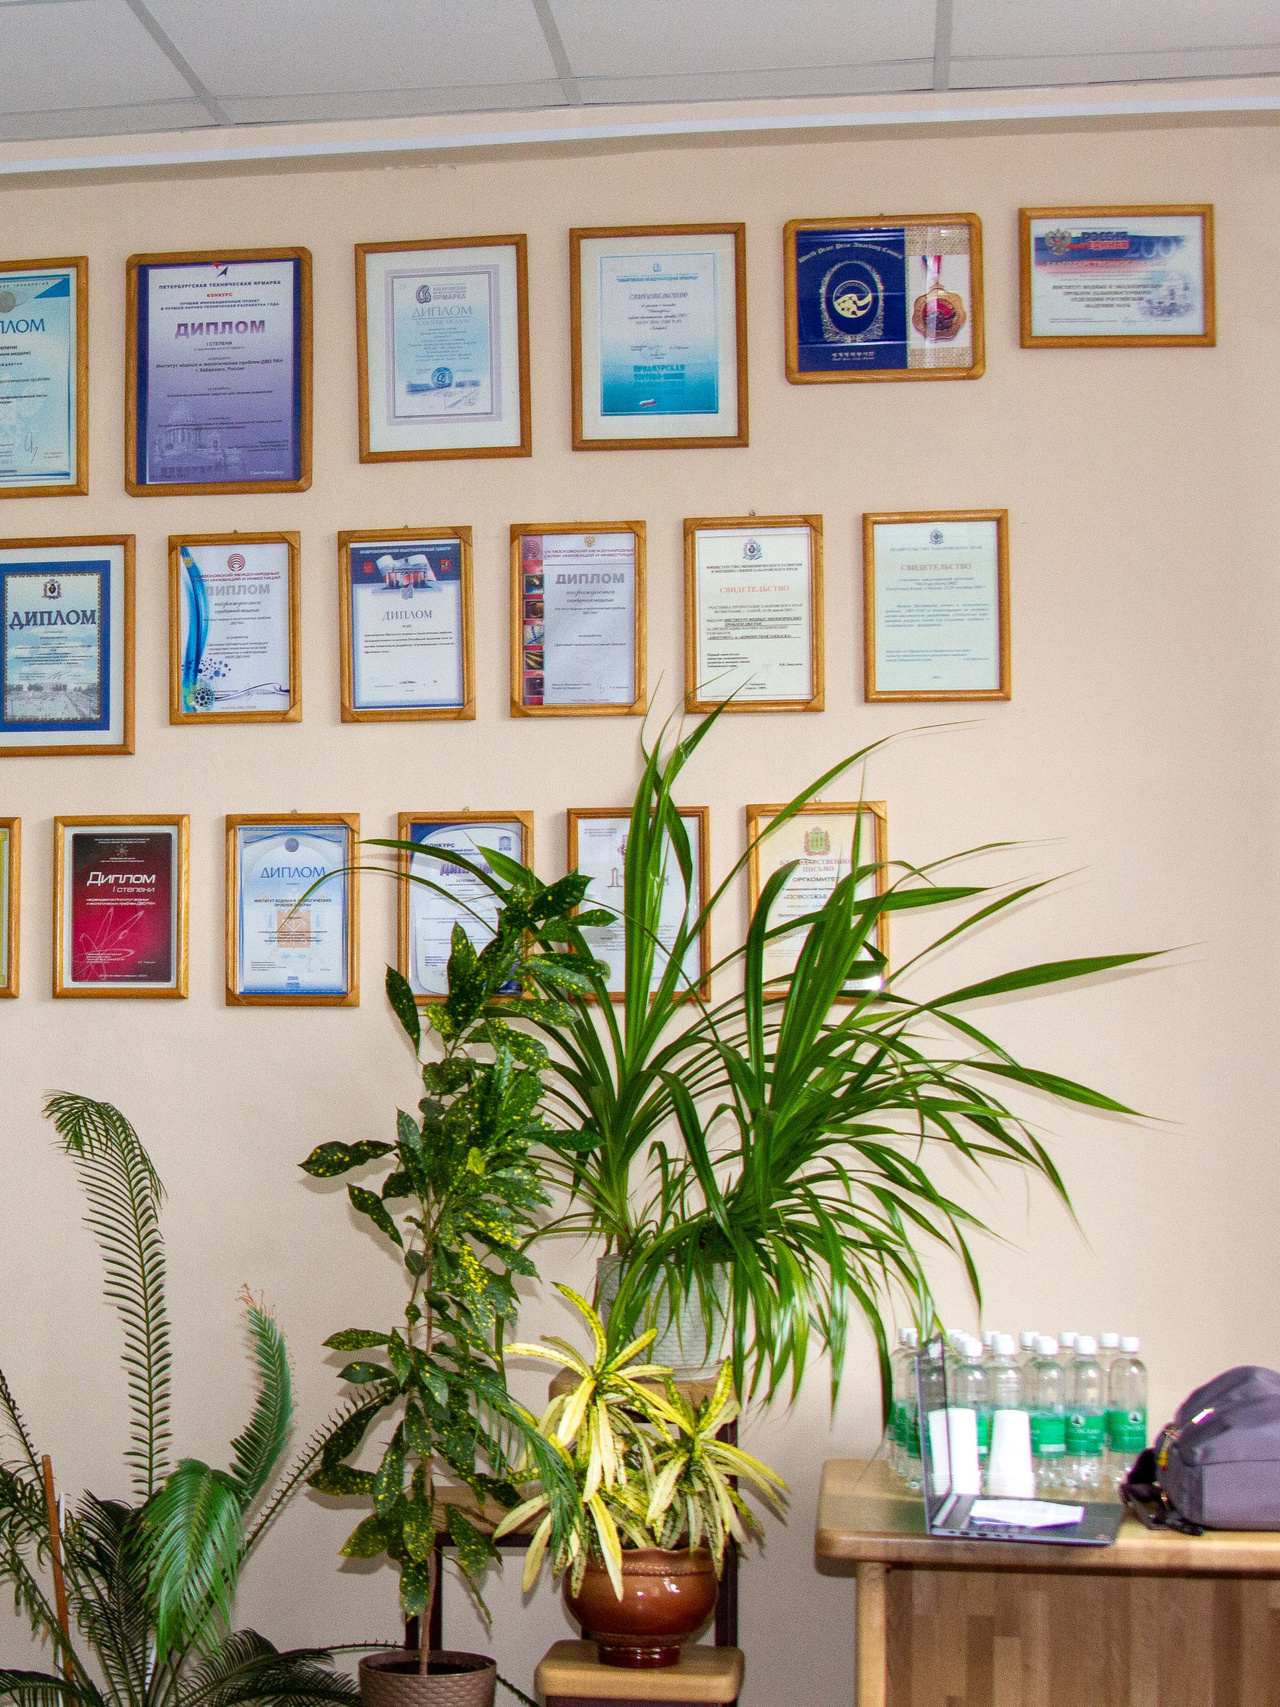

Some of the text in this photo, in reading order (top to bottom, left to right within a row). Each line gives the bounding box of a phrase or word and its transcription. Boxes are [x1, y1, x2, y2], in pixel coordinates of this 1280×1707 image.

[798, 251, 817, 263] World
[852, 242, 881, 251] Awarding
[882, 247, 903, 259] Council
[432, 293, 466, 301] ЯРМАРКА
[412, 305, 472, 317] ДИПЛОМ
[174, 319, 265, 339] ДИПЛОМ
[900, 563, 972, 571] СВИДЕТЕЛЬСТВО
[555, 572, 625, 585] ДИПЛОМ
[205, 584, 271, 596] ДИПЛОМ
[565, 589, 615, 597] награждается
[719, 585, 790, 594] СВИДЕТЕЛЬСТВО
[9, 609, 97, 631] ДИПЛОМ
[381, 609, 433, 621] ДИПЛОМ
[260, 866, 326, 879] ДИПЛОМ
[86, 871, 156, 887] Диплом
